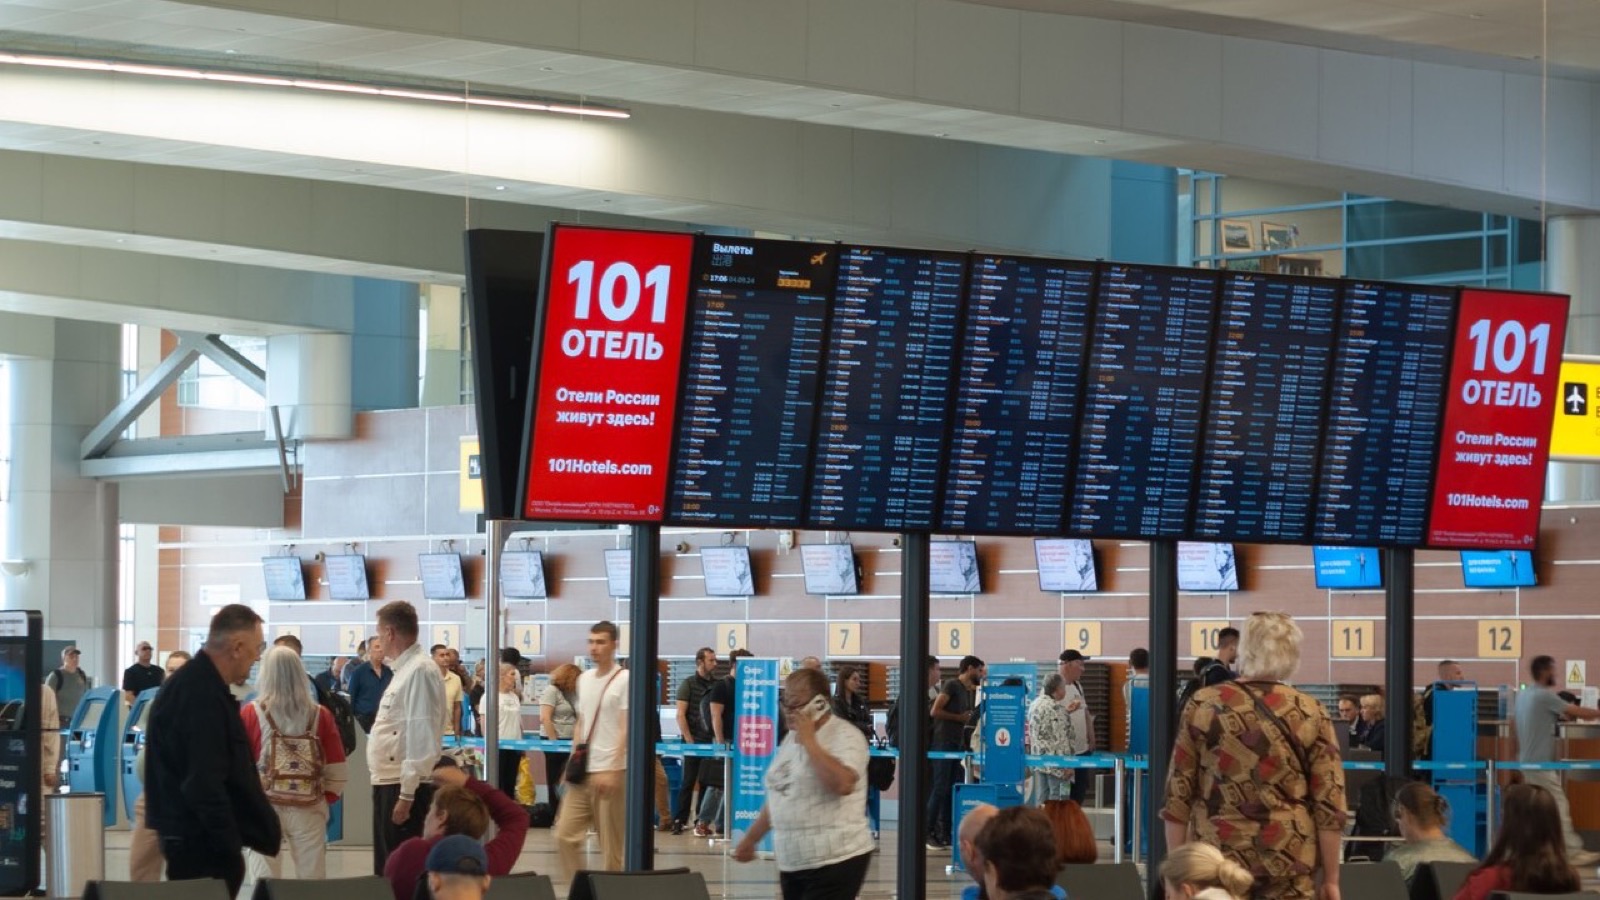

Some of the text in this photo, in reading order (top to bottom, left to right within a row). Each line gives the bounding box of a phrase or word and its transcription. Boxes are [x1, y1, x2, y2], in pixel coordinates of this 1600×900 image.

[713, 242, 754, 255] Вылеты
[568, 260, 670, 324] 101
[561, 329, 664, 360] ОТЕЛЬ
[1469, 319, 1551, 375] 101
[556, 387, 661, 406] Отели России
[1462, 379, 1542, 408] ОТЕЛЬ
[556, 410, 655, 428] живут здесь!
[1456, 431, 1537, 448] Отели России
[548, 458, 652, 475] 101Hotels.com
[1455, 452, 1532, 466] живут здесь!
[648, 504, 660, 515] 0+
[1446, 494, 1529, 510] 101Hotels.com
[349, 630, 355, 648] 2
[523, 629, 531, 648] 4
[728, 630, 736, 648] 6
[840, 629, 850, 649] 7
[950, 628, 960, 650] 8
[1079, 628, 1090, 649] 9
[1200, 628, 1220, 650] 10
[1343, 628, 1363, 650] 11
[1488, 627, 1512, 650] 12
